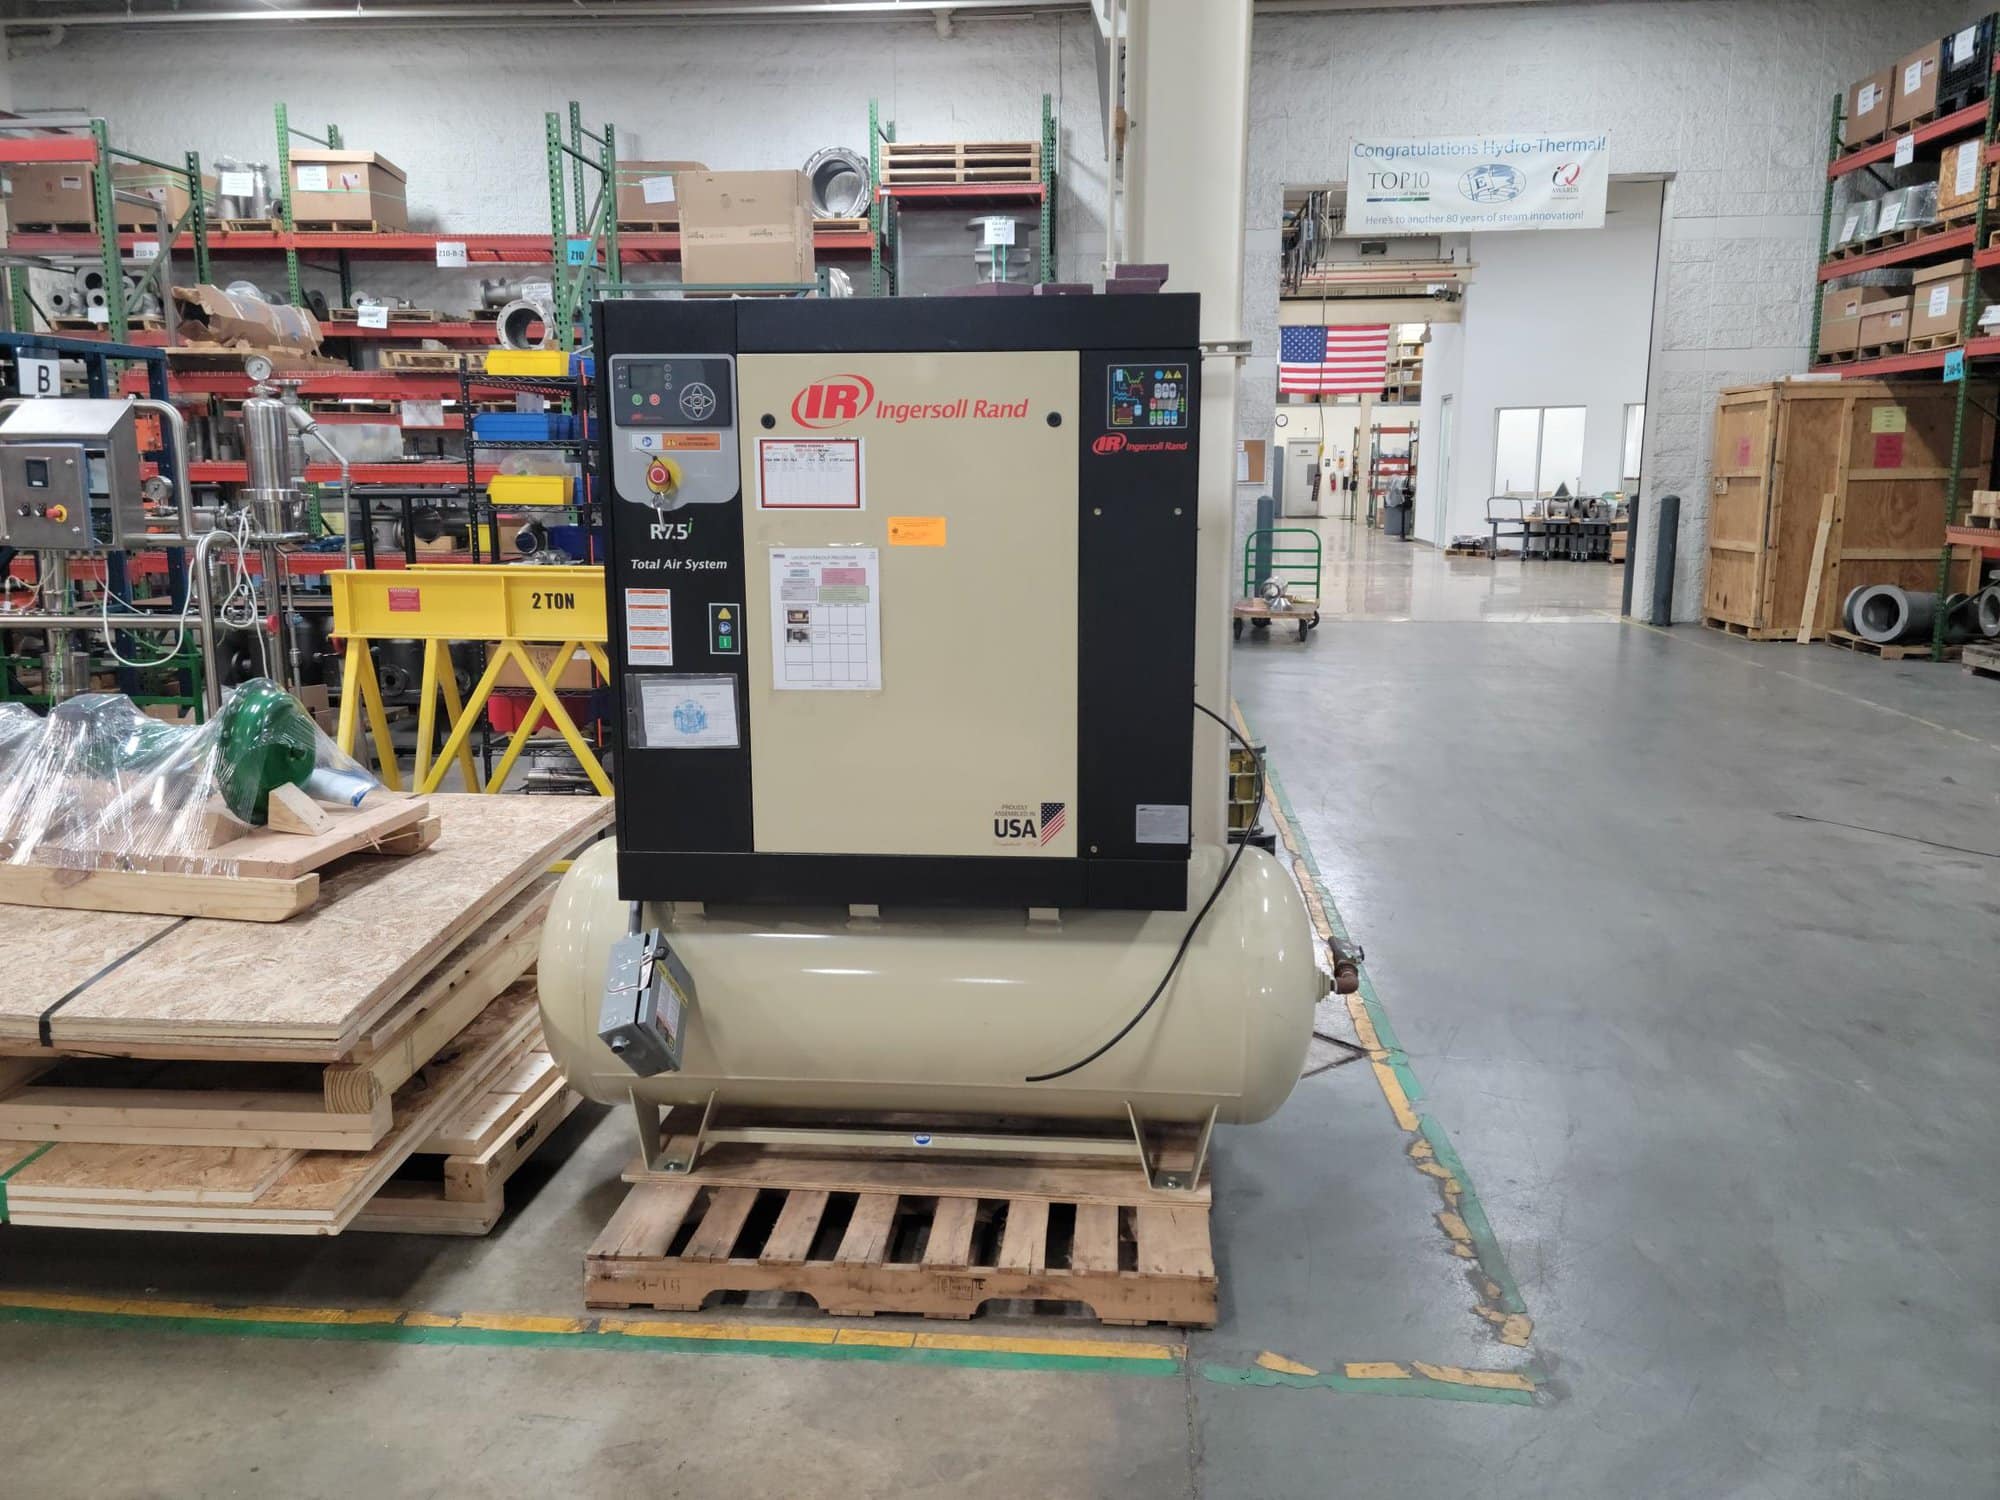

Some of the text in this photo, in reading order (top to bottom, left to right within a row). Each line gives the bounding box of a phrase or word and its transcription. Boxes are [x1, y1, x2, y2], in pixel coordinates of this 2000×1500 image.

[1354, 136, 1606, 160] Congratulations Hydro-Thermal!
[1475, 178, 1487, 190] E
[1366, 210, 1584, 225] Here's to another 80 years of steam innovation!
[38, 365, 50, 393] B
[804, 385, 1029, 423] IR Ingersoll Rand
[1126, 442, 1165, 452] Ingersoll
[1165, 441, 1188, 451] Rand
[631, 559, 728, 571] Total Air System
[532, 592, 575, 609] 2 TON
[993, 818, 1037, 838] USA
